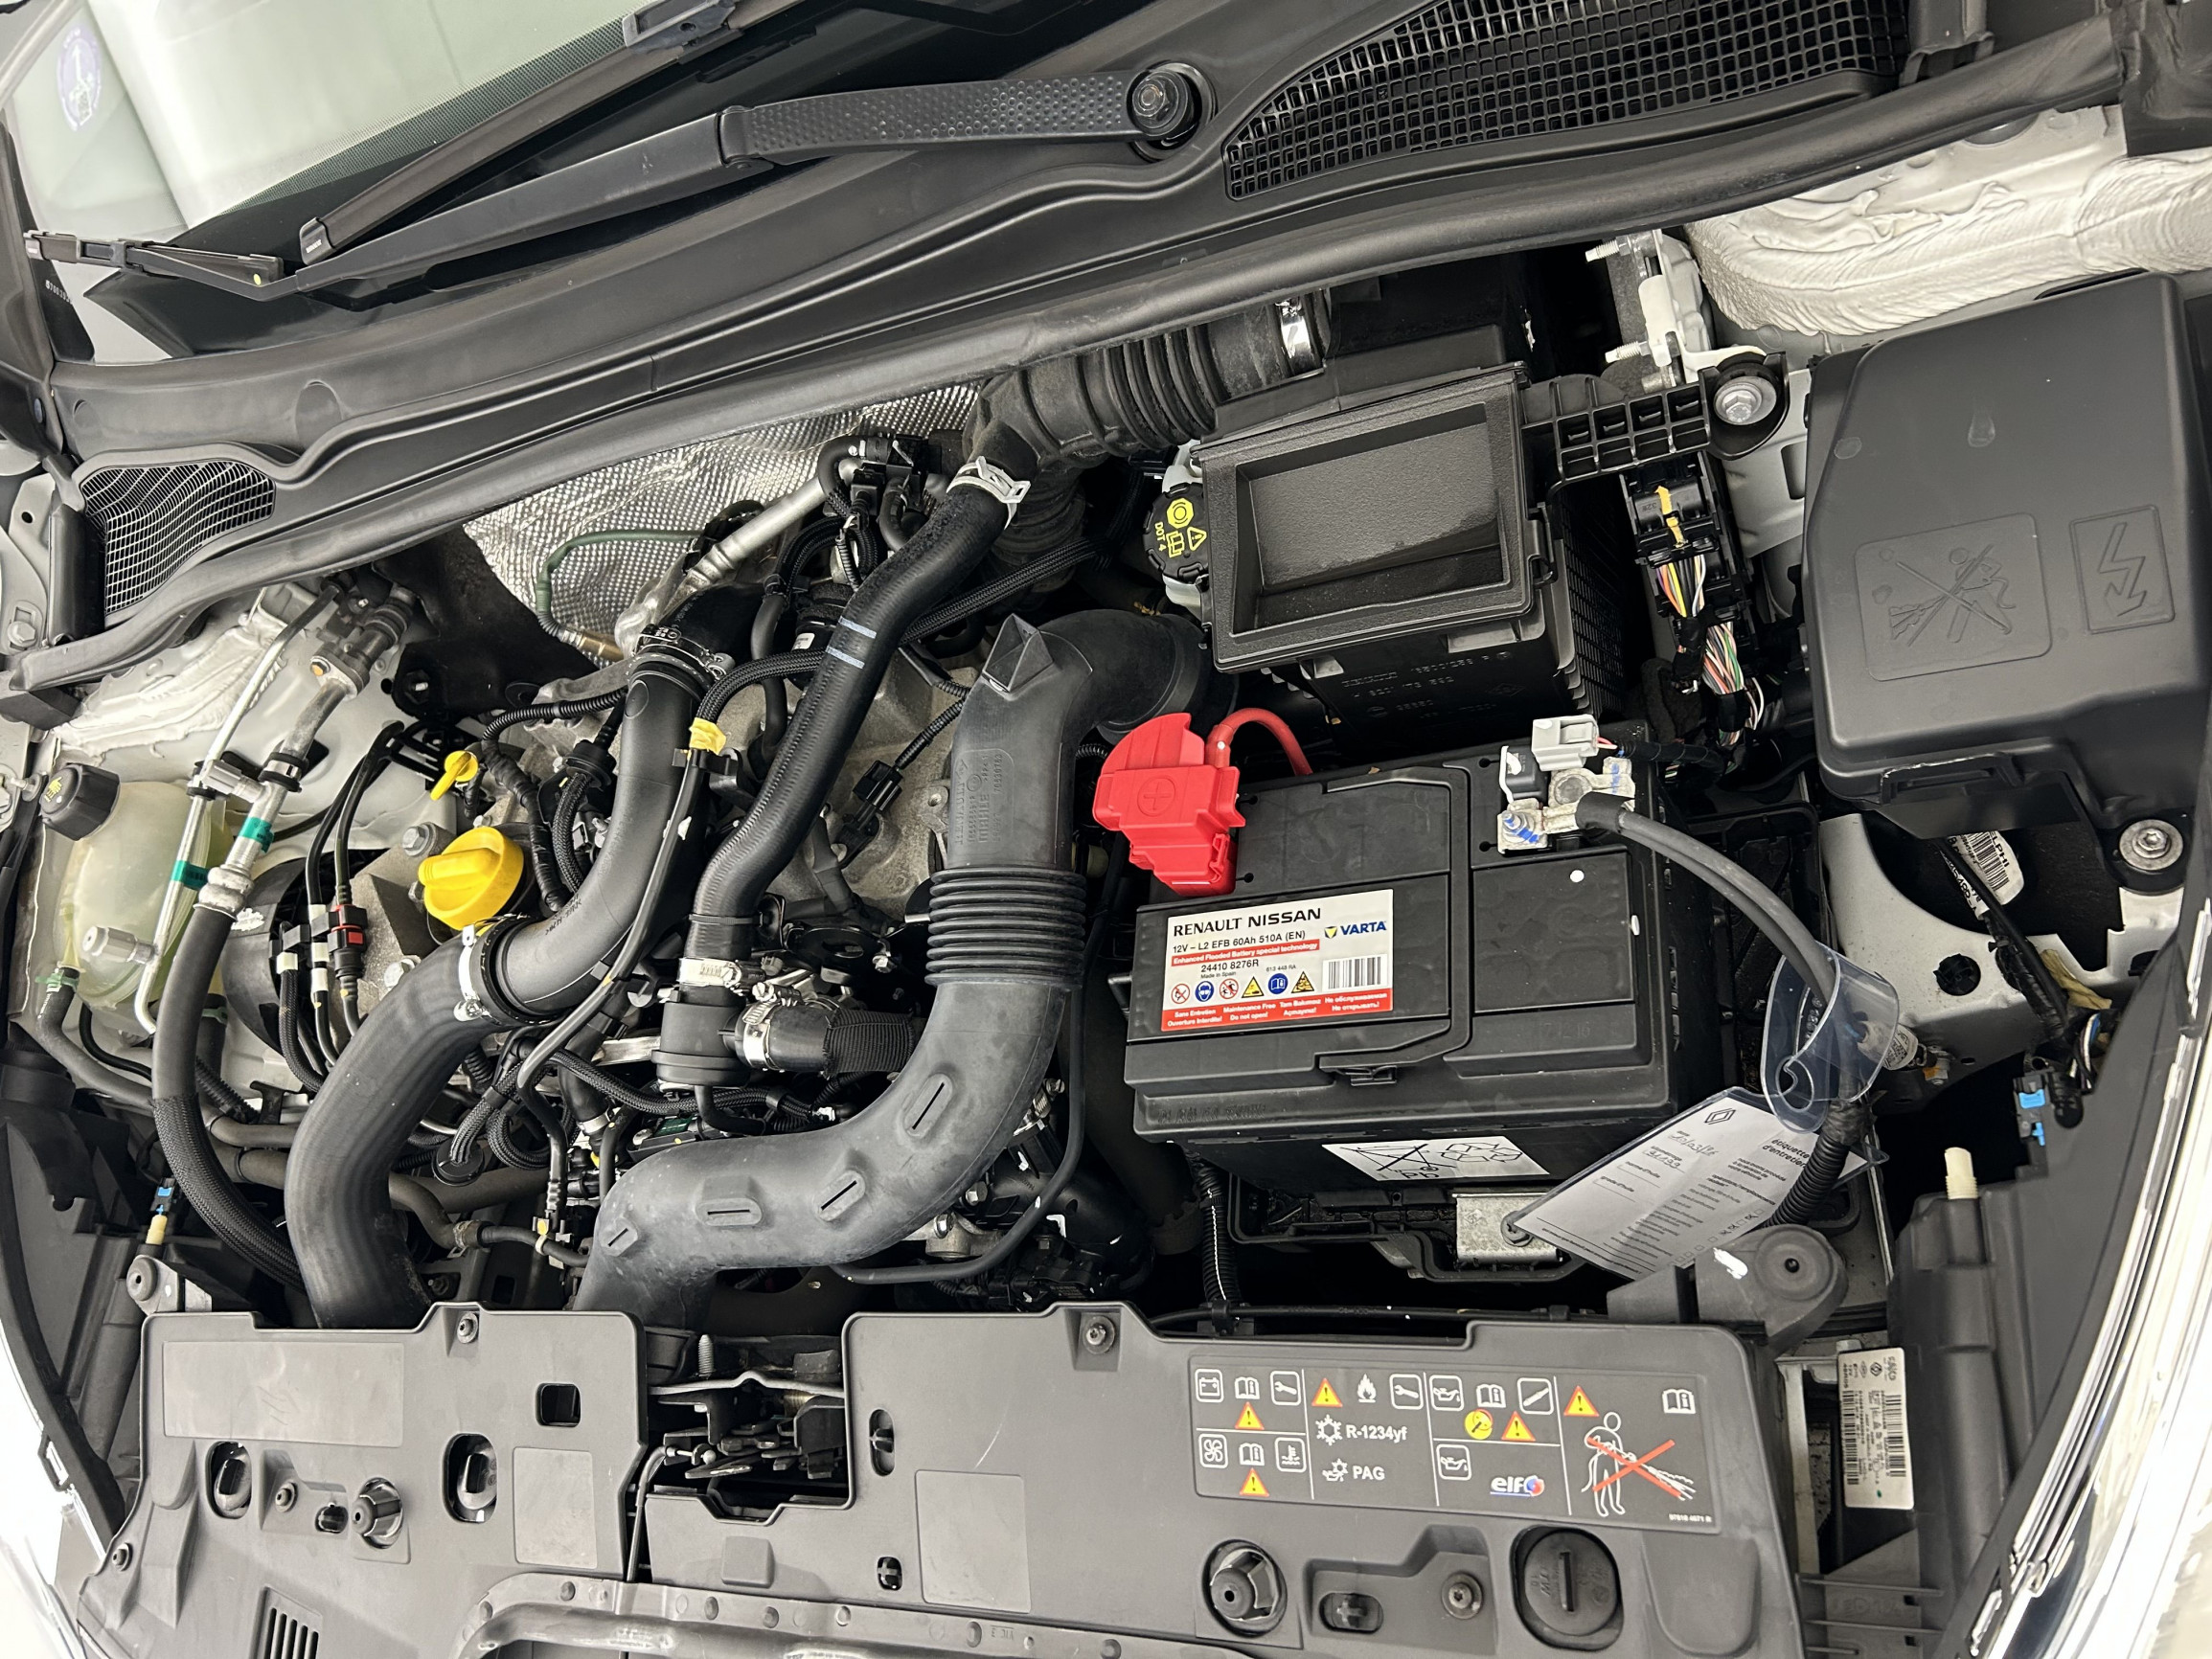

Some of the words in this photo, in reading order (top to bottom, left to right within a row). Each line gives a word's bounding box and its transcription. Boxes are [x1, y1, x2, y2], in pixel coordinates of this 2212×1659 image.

[1154, 521, 1165, 541] DOT
[1159, 543, 1167, 552] 4
[1174, 918, 1243, 937] RENAULT
[1248, 908, 1321, 928] NISSAN
[1340, 921, 1387, 935] VARTA
[1174, 944, 1188, 954] 12V
[1198, 942, 1209, 951] L2
[1212, 939, 1230, 948] EFB
[1233, 937, 1255, 946] 60Ah
[1259, 933, 1282, 943] 510A
[1285, 930, 1306, 942] (EN)
[1173, 955, 1204, 965] Enhanced
[1205, 952, 1231, 961] Flooded
[1231, 949, 1255, 959] Battery
[1256, 946, 1280, 956] special
[1281, 942, 1318, 953] technology
[1201, 962, 1228, 973] 24410
[1230, 959, 1259, 969] 8276R
[1223, 1005, 1261, 1013] Maintenance
[1770, 1137, 1811, 1159] étiquette
[1345, 1424, 1408, 1444] R-1234yf
[1352, 1466, 1386, 1480] PAG
[1490, 1476, 1526, 1493] elf
